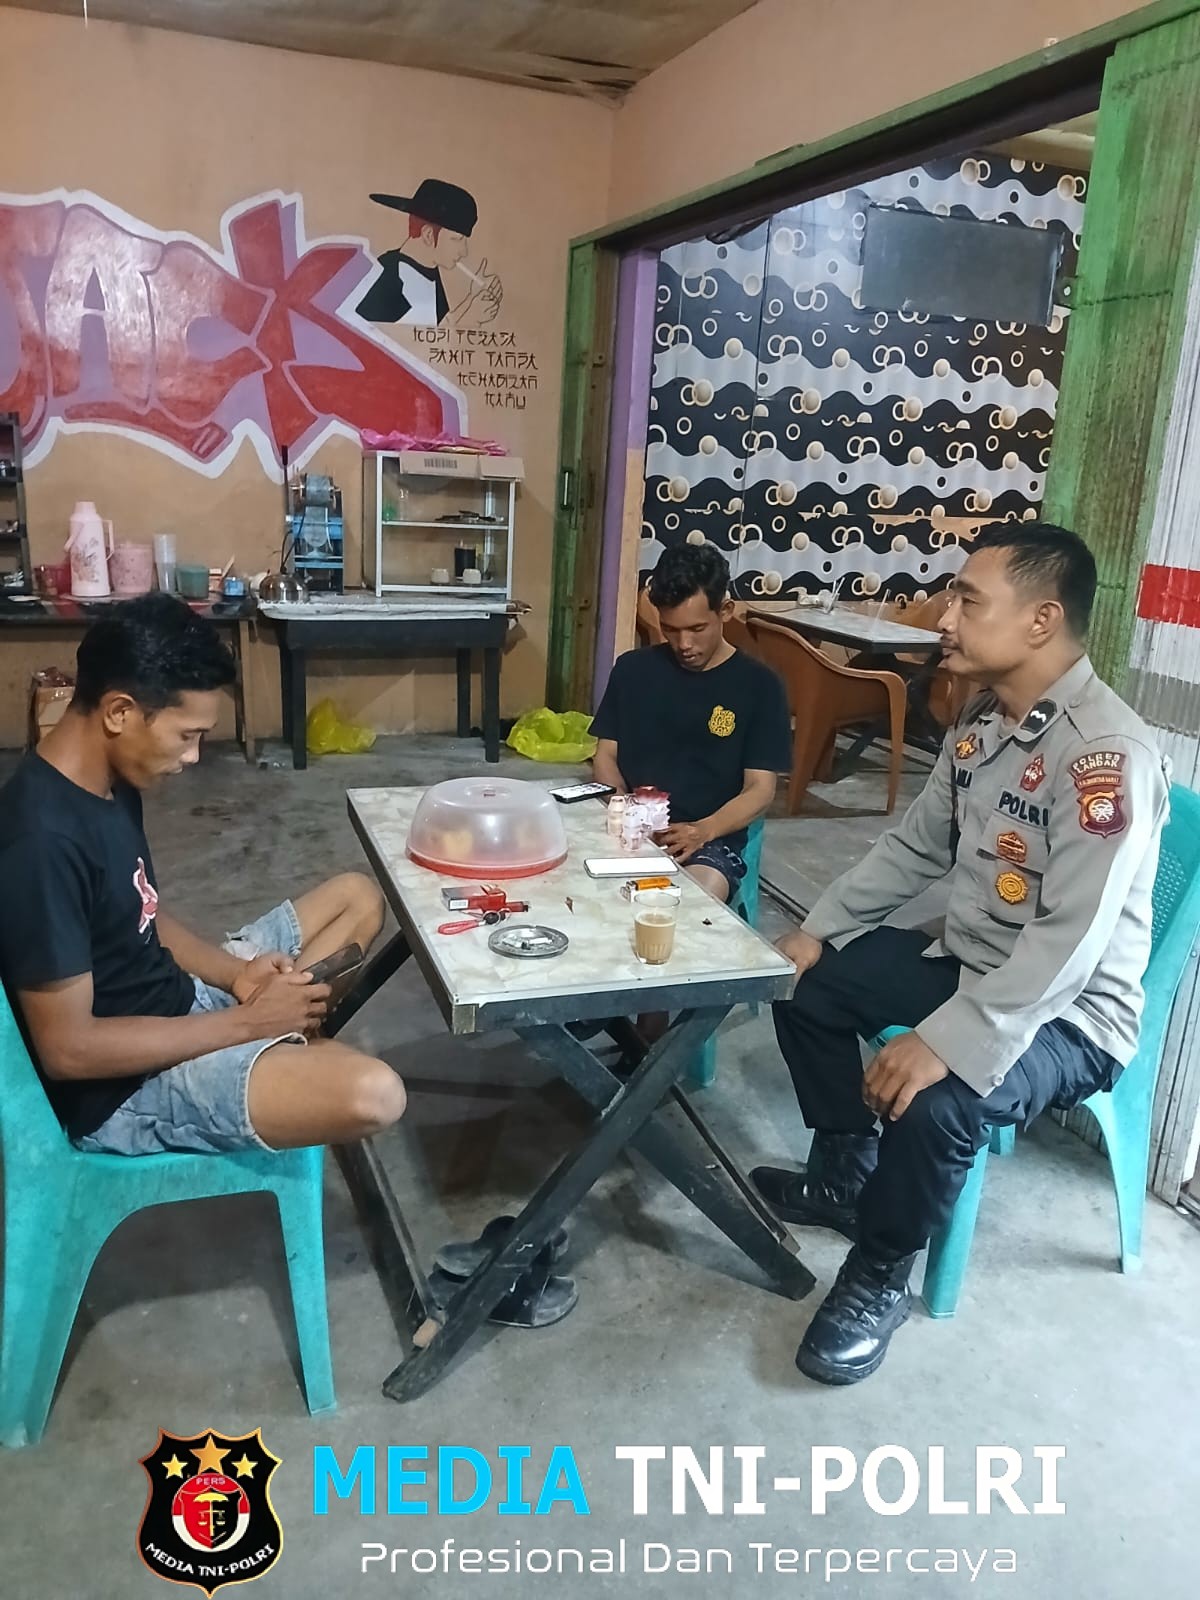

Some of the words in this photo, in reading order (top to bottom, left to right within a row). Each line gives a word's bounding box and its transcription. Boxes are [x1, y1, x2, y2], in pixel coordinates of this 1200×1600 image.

[413, 326, 450, 344] KOPI
[486, 352, 538, 370] TANPA
[485, 392, 526, 409] KAMU
[1072, 753, 1121, 770] POLRES
[1077, 760, 1118, 774] LANDAK
[998, 791, 1049, 826] POLRI
